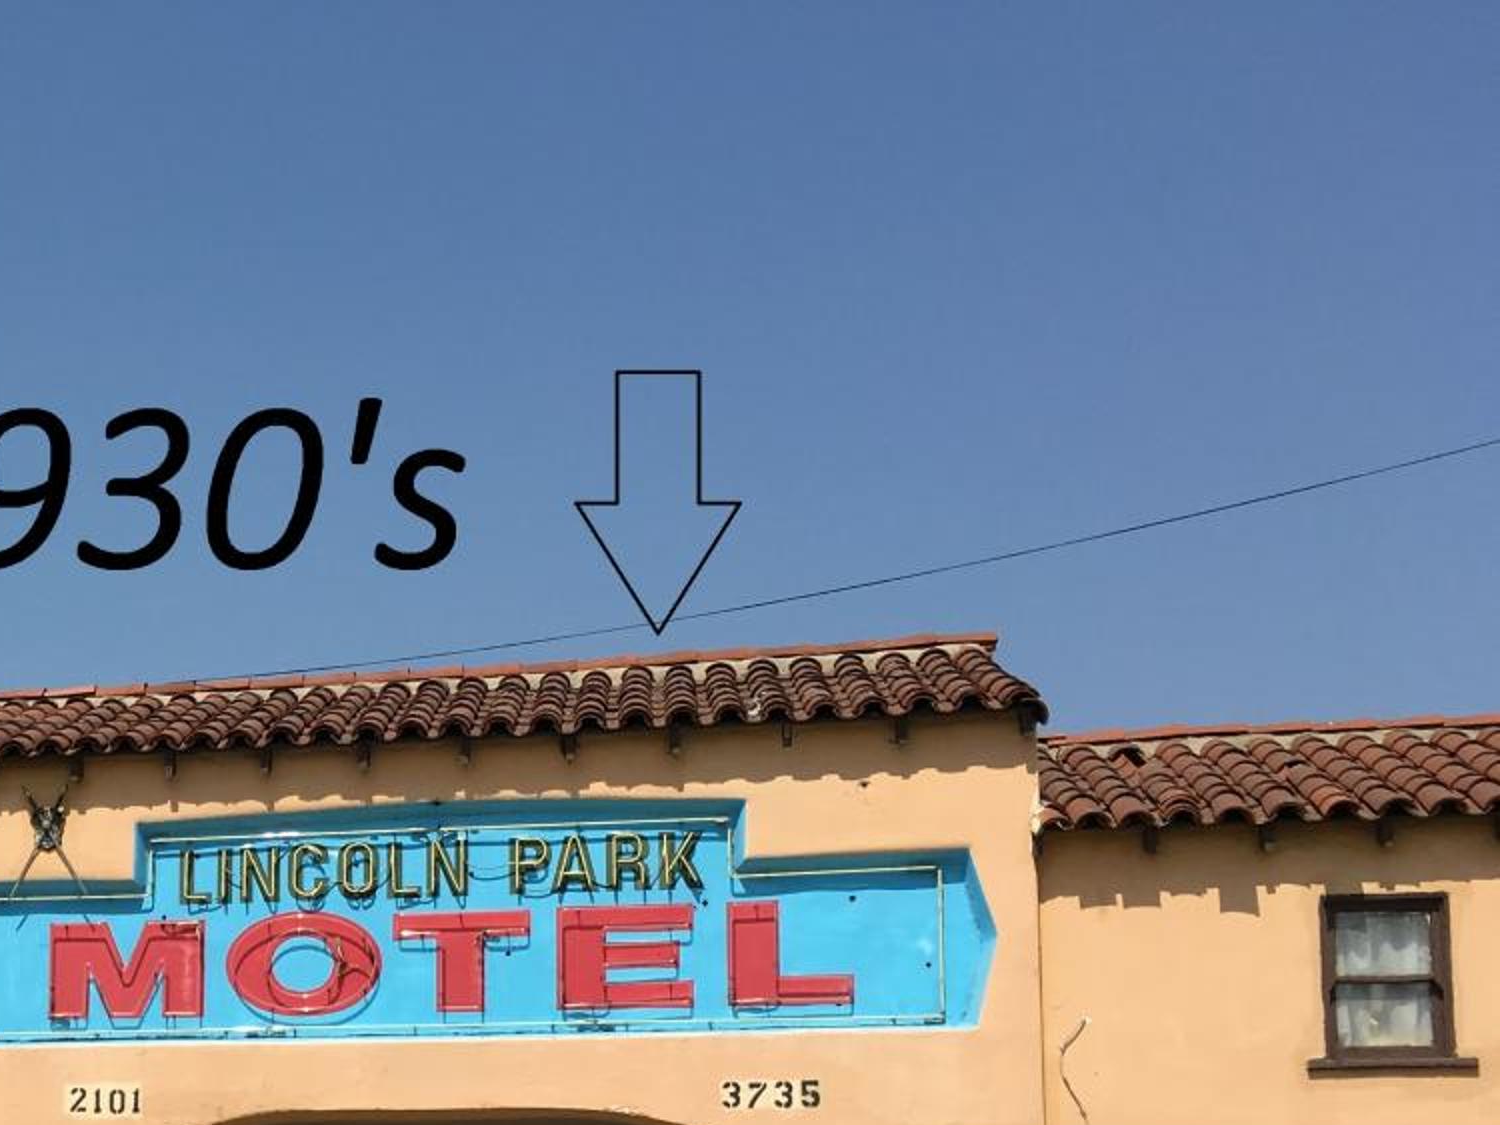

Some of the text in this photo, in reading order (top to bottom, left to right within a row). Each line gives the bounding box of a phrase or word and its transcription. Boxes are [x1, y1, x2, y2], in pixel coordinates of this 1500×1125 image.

[180, 831, 705, 904] LINCOLN PARK
[49, 901, 854, 1019] MOTEL
[69, 1087, 141, 1115] 2101
[722, 1080, 820, 1109] 3735
